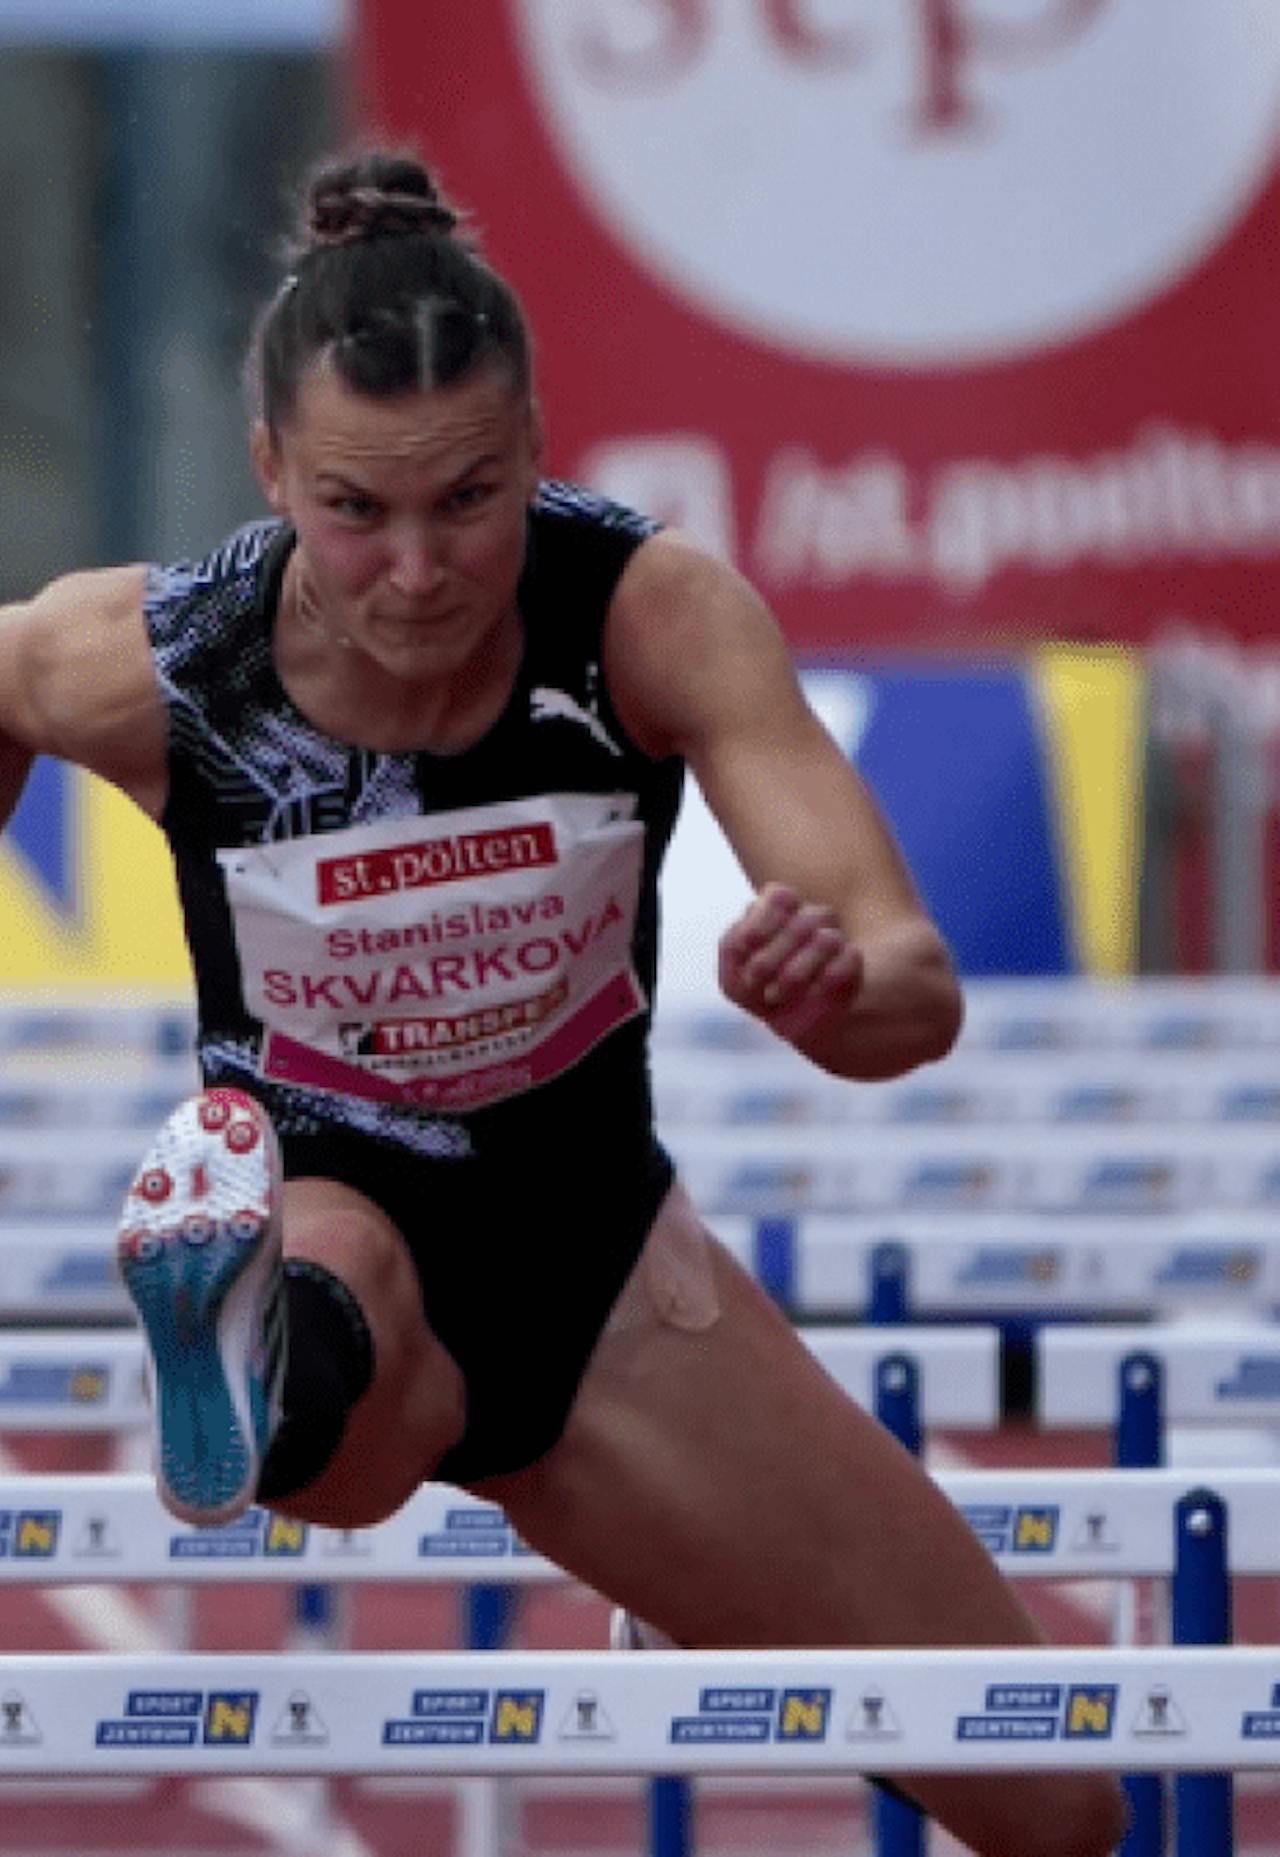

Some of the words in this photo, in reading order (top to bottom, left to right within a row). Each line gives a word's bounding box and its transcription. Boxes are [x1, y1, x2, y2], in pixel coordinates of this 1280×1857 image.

[333, 833, 541, 896] st.pölten
[325, 894, 565, 958] Stanislava
[207, 1699, 248, 1738] N
[494, 1698, 535, 1737] N
[780, 1696, 821, 1735] N
[1066, 1693, 1107, 1732] N
